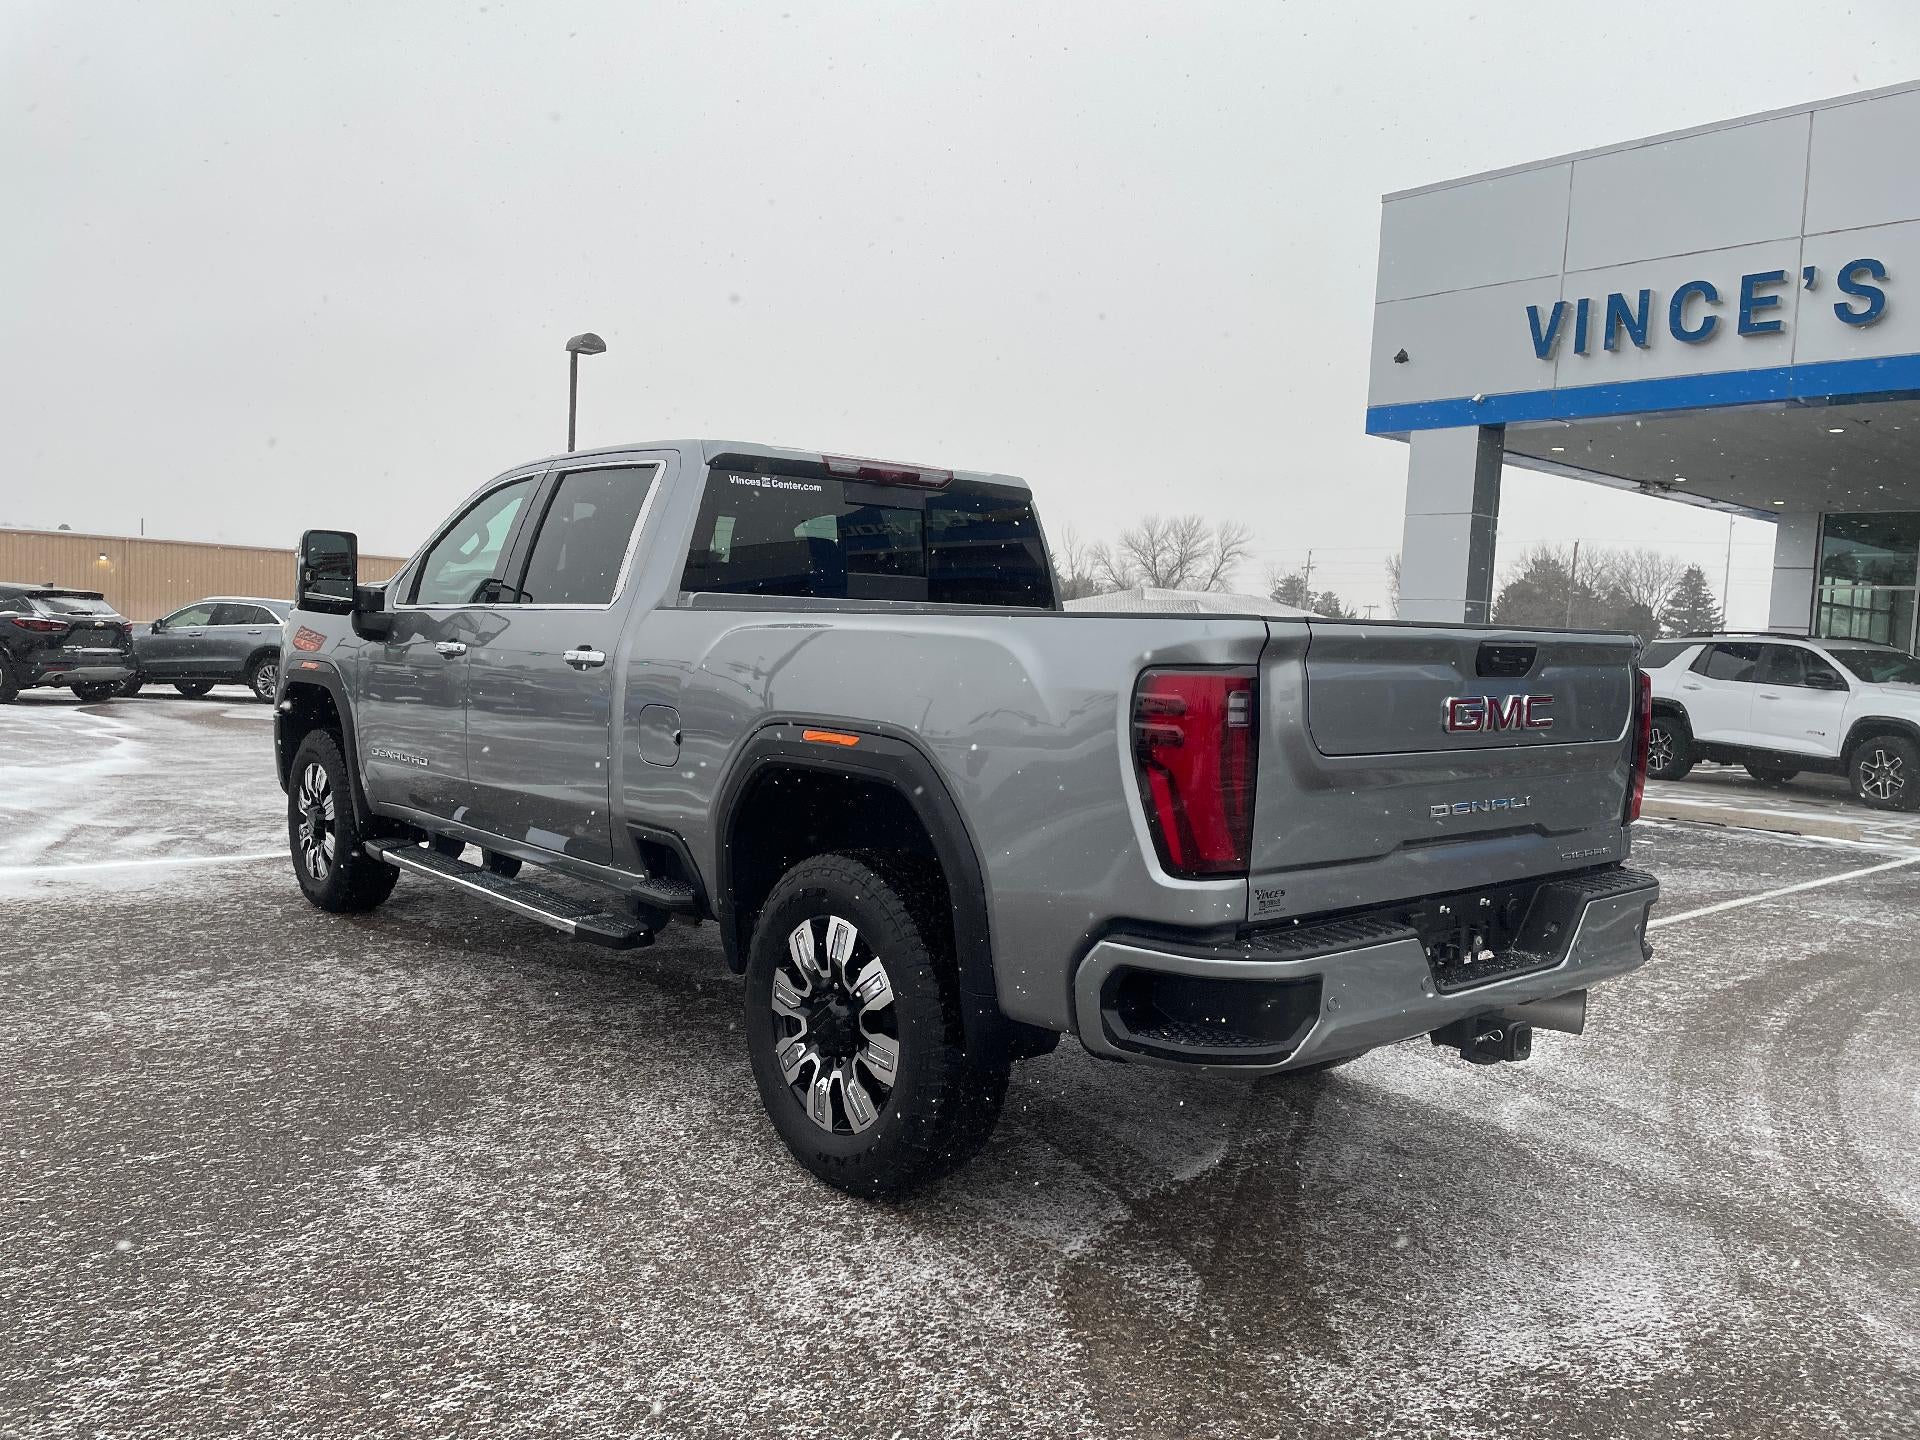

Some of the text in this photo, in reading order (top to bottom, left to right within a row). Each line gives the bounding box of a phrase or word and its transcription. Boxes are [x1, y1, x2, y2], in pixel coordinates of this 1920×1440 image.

[1526, 258, 1890, 361] VINCE'S
[1442, 694, 1554, 733] GMC
[371, 747, 410, 762] DENALI
[1430, 796, 1531, 818] DENALI
[1561, 847, 1612, 860] SIERRA
